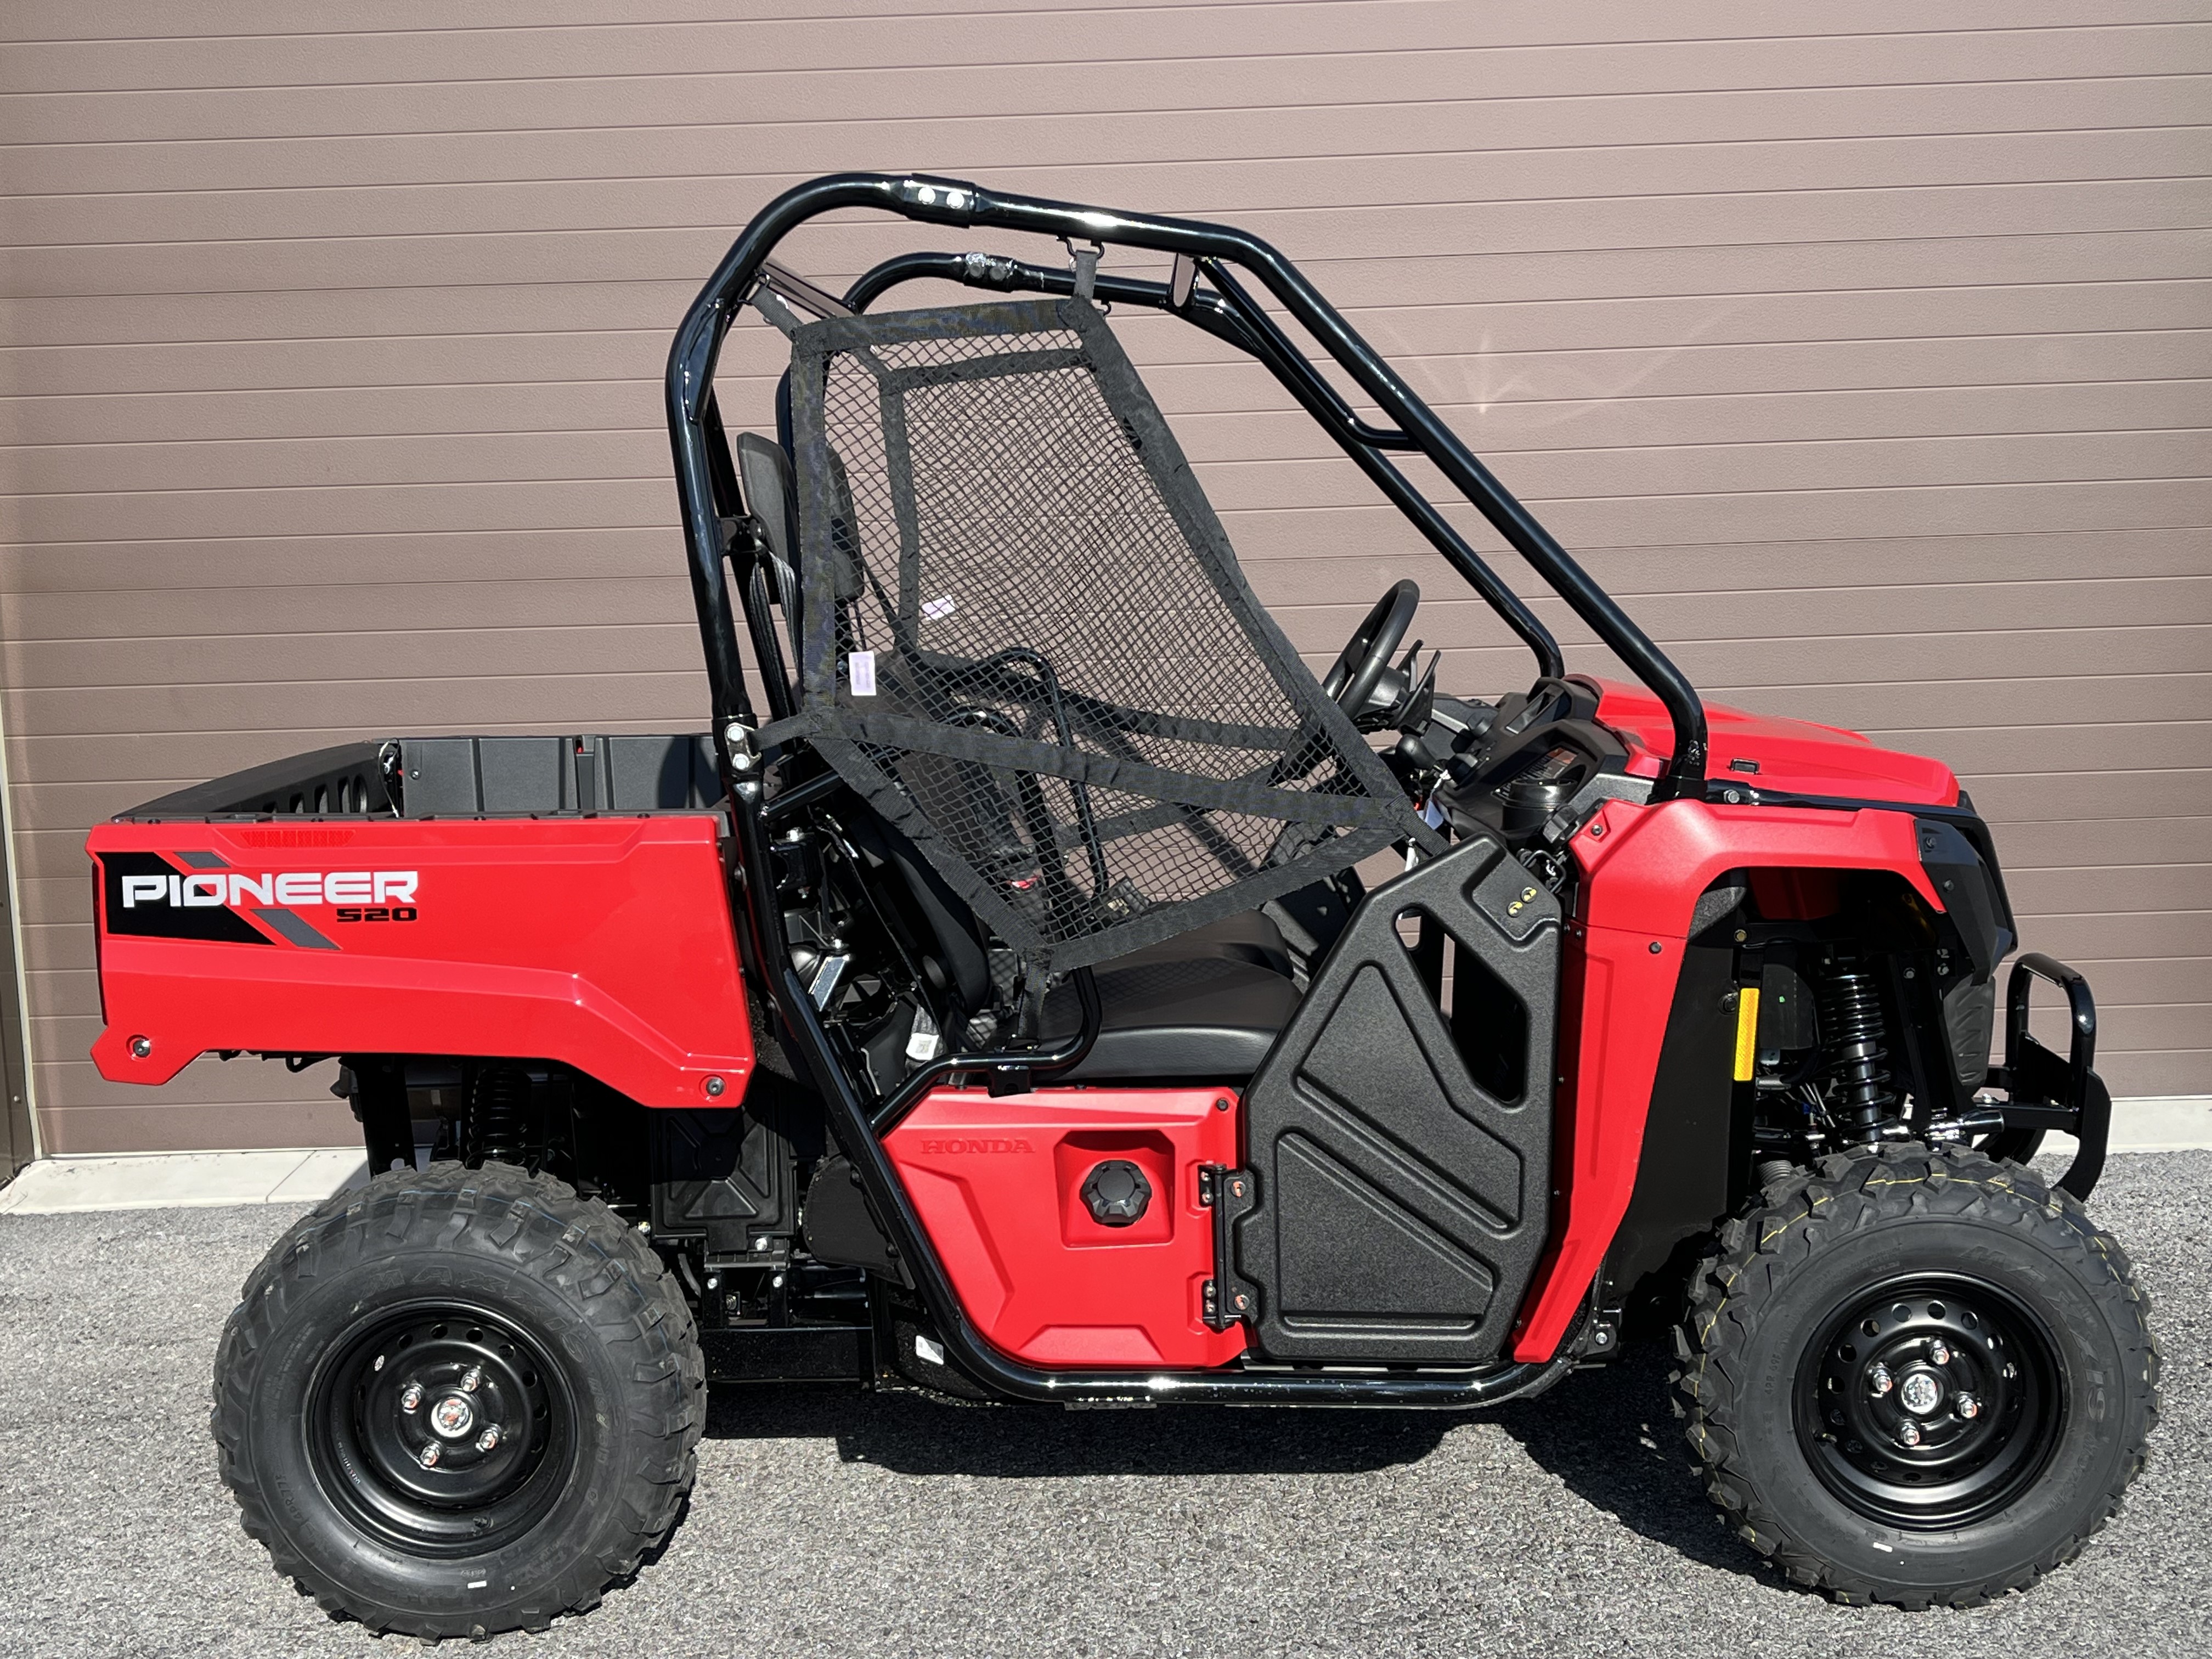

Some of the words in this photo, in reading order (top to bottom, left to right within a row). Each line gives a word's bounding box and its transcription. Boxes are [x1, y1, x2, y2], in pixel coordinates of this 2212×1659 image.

[122, 871, 419, 908] PIONEER
[336, 907, 417, 922] 520
[921, 1138, 1036, 1154] HONDA
[360, 1265, 591, 1364] MAXXIS
[1957, 1245, 2106, 1423] MAXXIS
